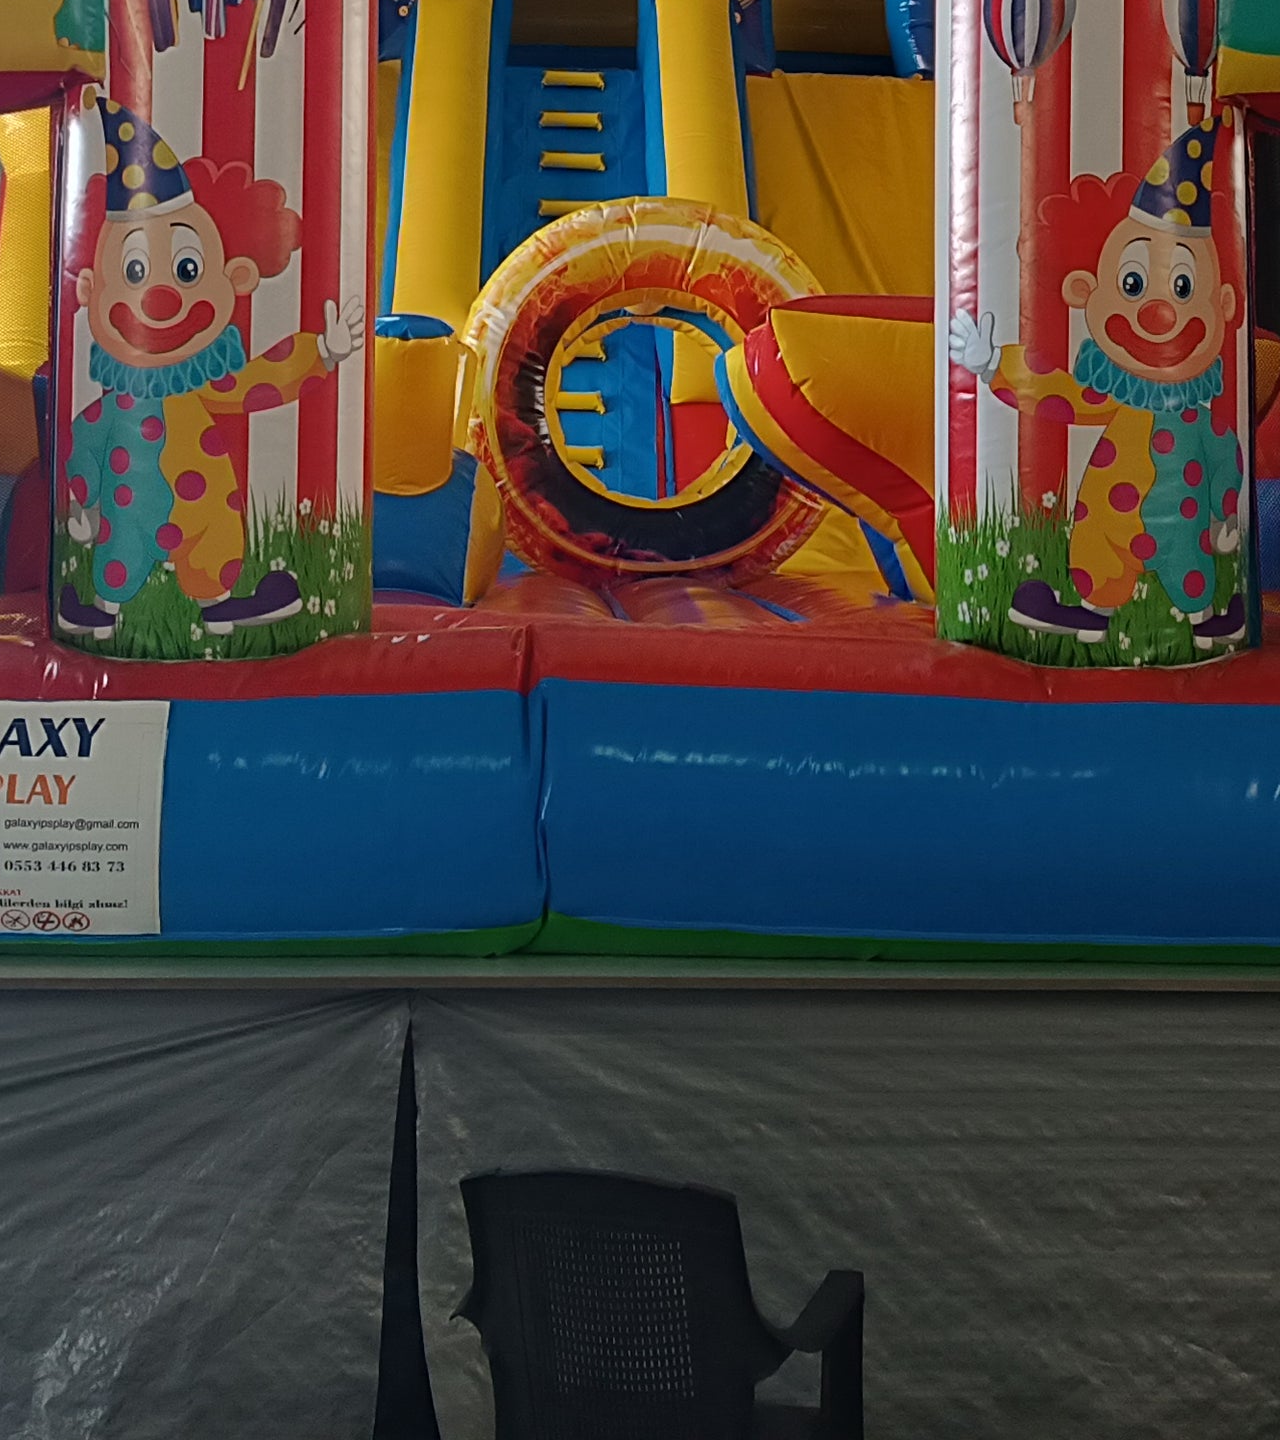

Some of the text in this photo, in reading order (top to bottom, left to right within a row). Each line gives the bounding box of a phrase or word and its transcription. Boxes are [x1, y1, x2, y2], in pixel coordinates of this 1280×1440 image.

[4, 817, 140, 831] galaxyipsplay@gmail.com
[2, 840, 129, 853] www.galaxyipsplay.com
[3, 859, 42, 872] 0553
[81, 860, 100, 873] 83
[106, 860, 126, 873] 73
